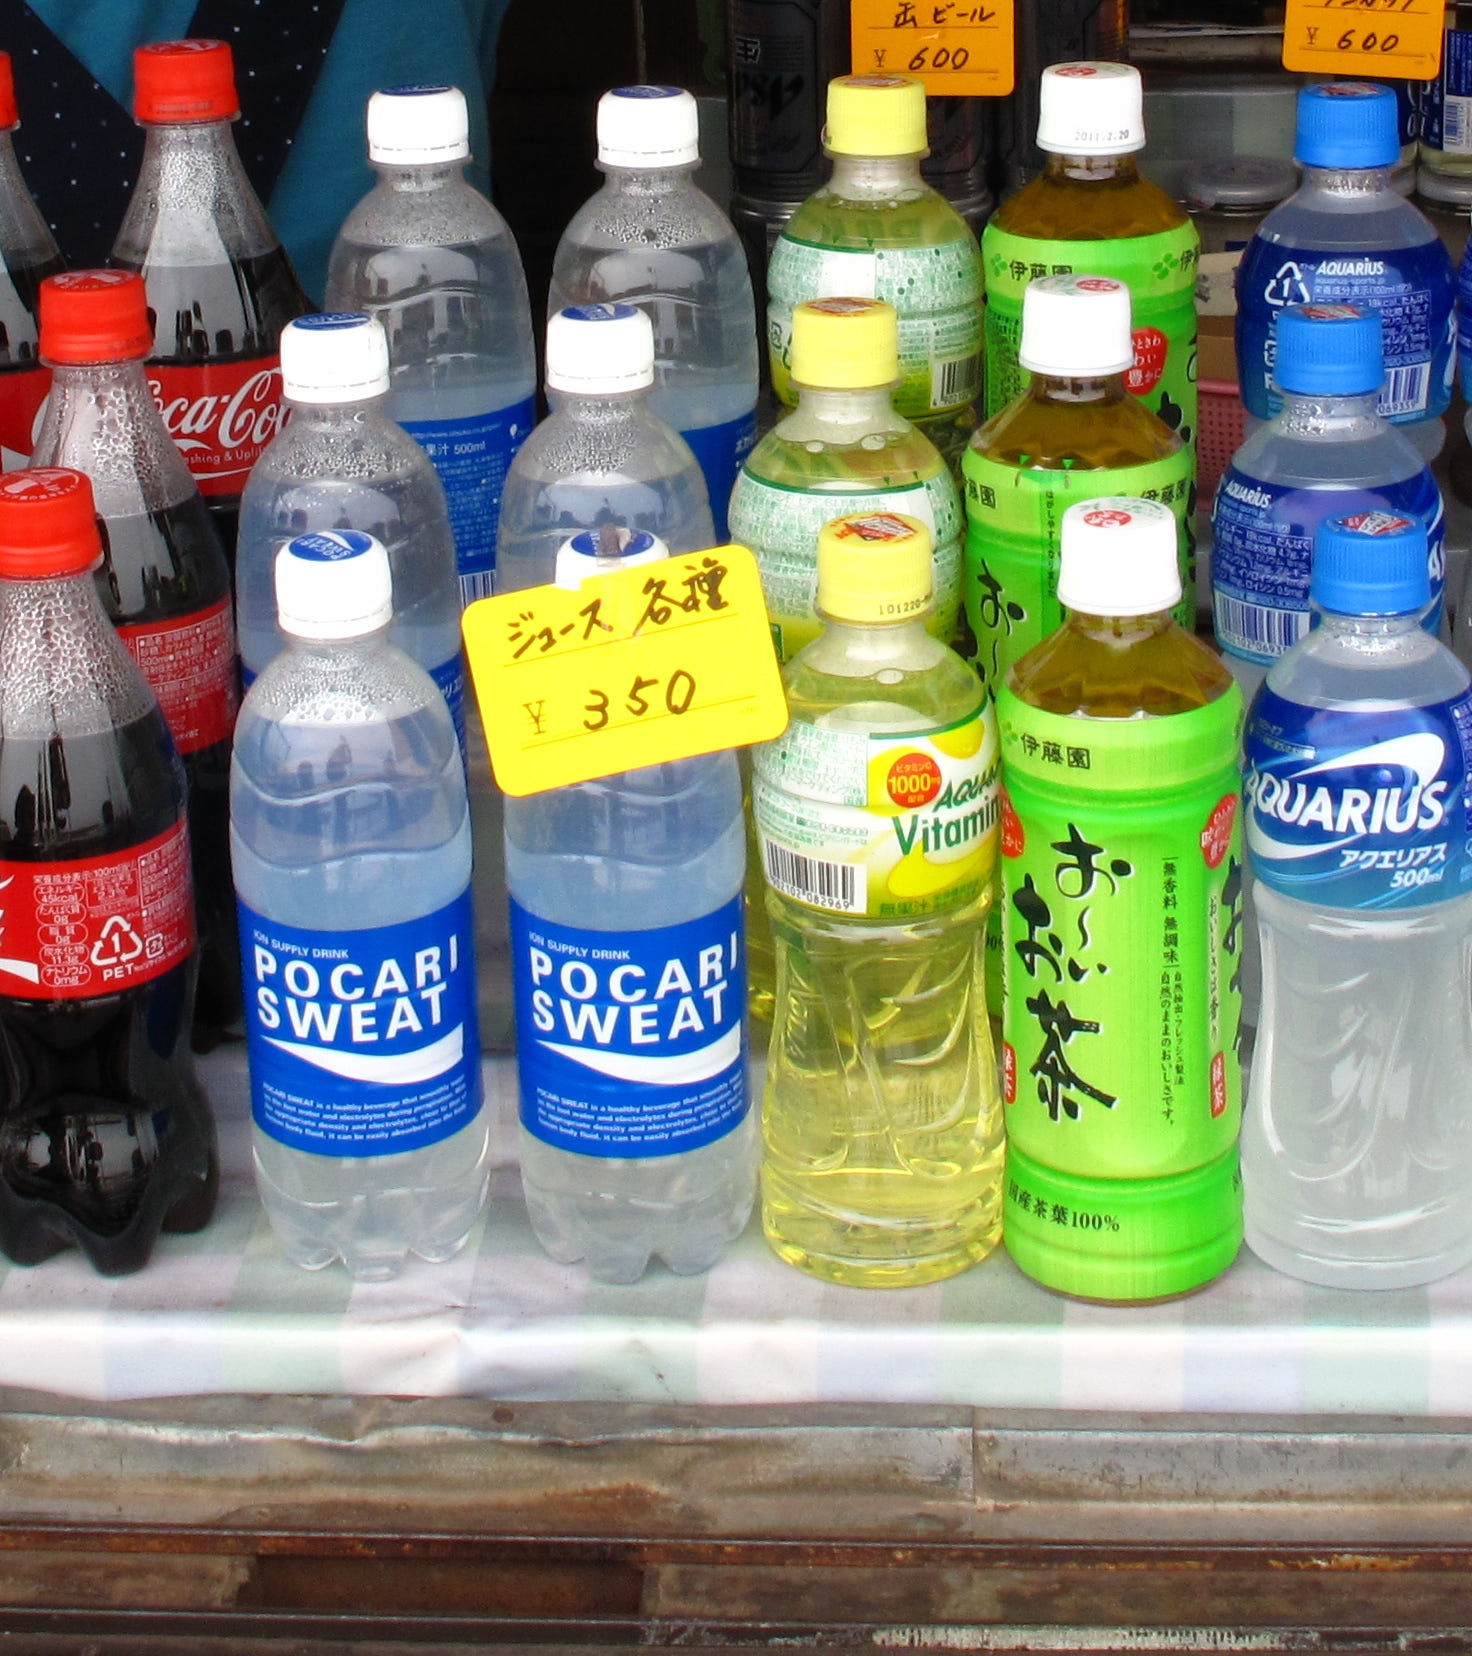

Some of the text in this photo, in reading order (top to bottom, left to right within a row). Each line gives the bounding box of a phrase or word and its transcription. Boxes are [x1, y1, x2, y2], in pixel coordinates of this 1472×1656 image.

[1020, 731, 1092, 771] 伊藤園
[892, 794, 999, 856] Vitamin
[1247, 778, 1448, 836] AQUARIUS
[1338, 842, 1447, 870] アクエリアス
[103, 964, 134, 981] PET
[254, 934, 458, 1001] POCARI
[271, 939, 349, 959] SUPPLY DRINK
[530, 931, 738, 1004] POCARI
[547, 939, 631, 960] SUPPLY DRINK
[257, 981, 448, 1043] SWEAT
[532, 980, 728, 1044] SWEAT
[1009, 1179, 1120, 1233] 国産茶葉100%
